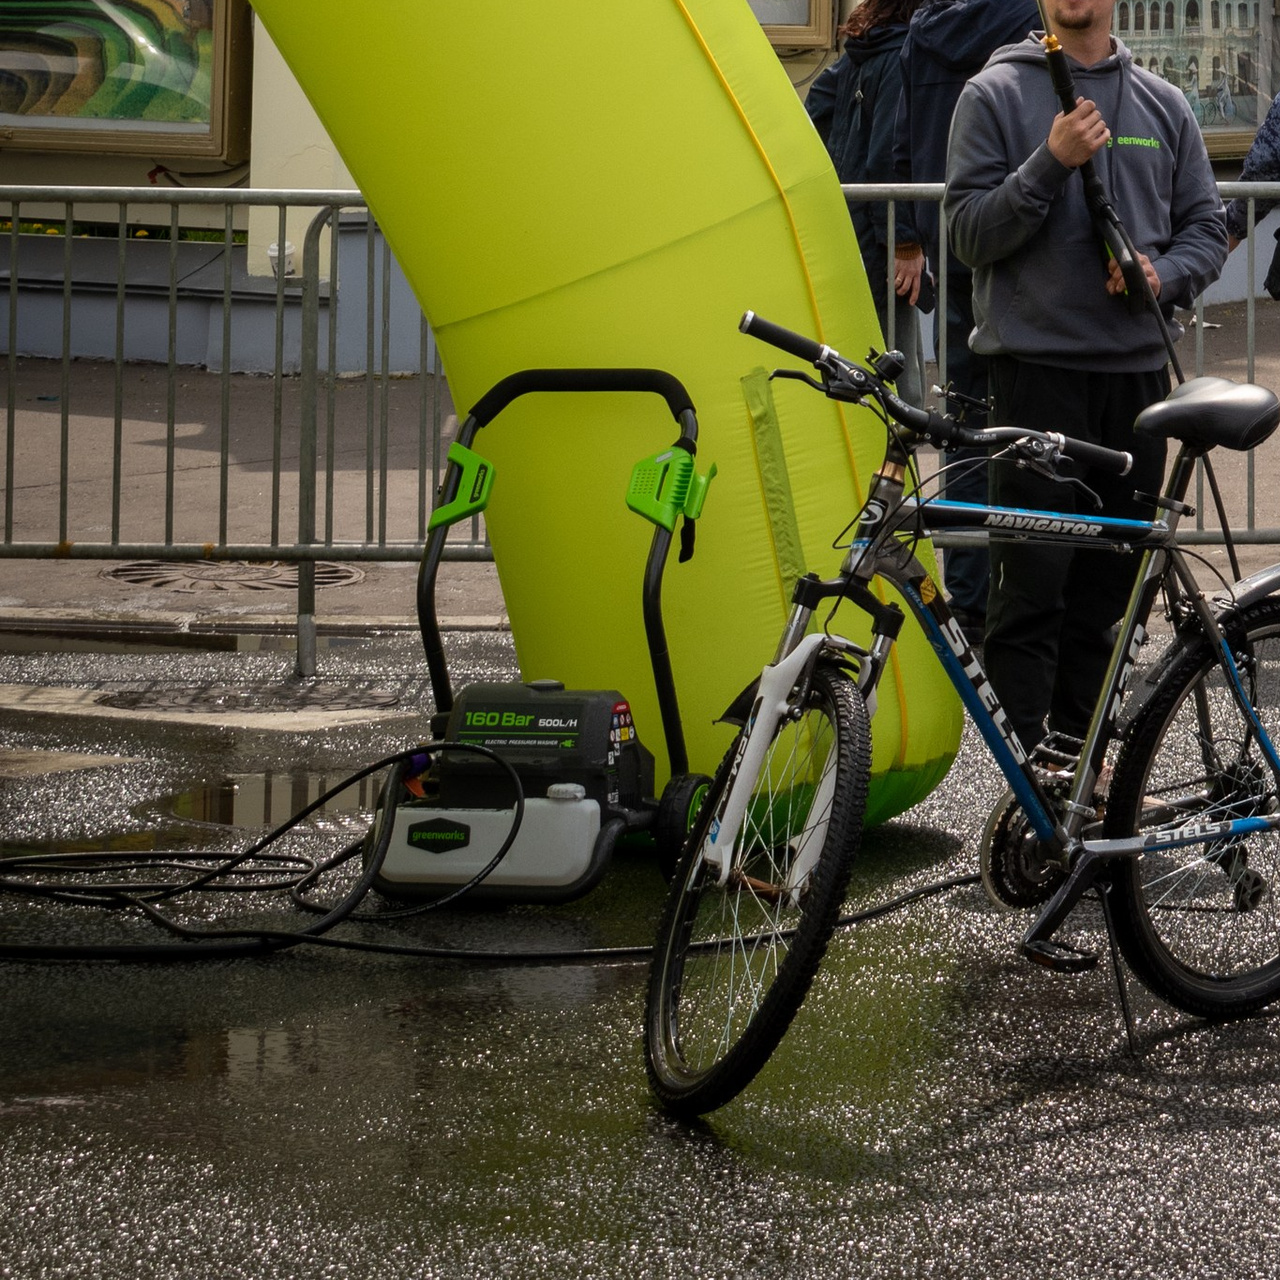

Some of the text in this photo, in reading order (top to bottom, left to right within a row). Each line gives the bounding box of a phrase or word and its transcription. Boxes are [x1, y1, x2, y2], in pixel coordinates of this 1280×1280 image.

[1107, 136, 1160, 149] geenworks
[983, 513, 1103, 537] NAVIGATOR
[939, 616, 1029, 766] STELS
[465, 712, 578, 728] 160 Bar 500L/H
[412, 830, 466, 842] greenworks
[1155, 822, 1222, 844] STELS
